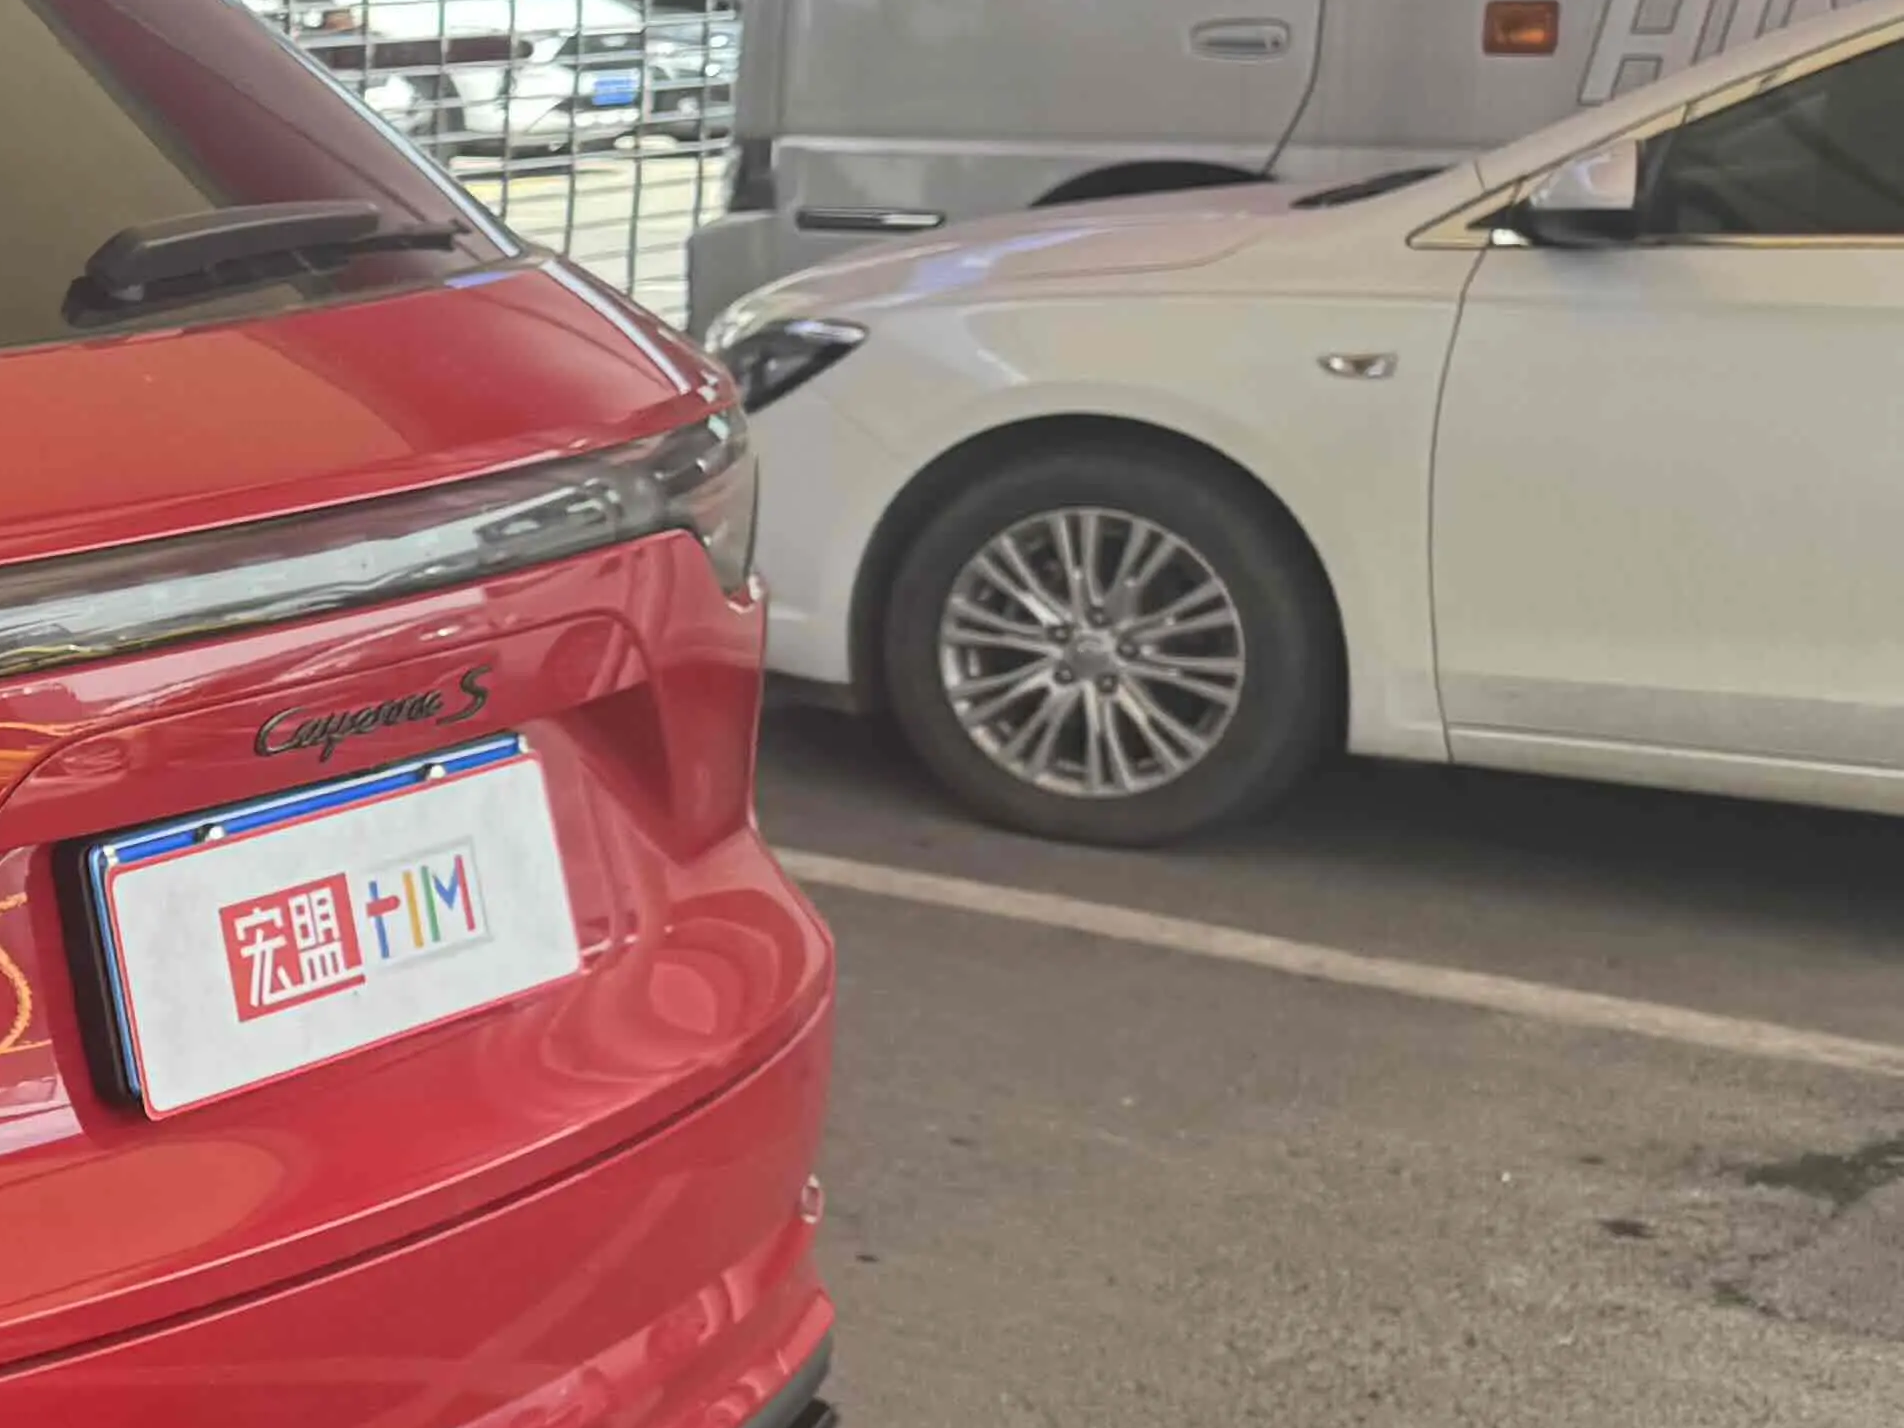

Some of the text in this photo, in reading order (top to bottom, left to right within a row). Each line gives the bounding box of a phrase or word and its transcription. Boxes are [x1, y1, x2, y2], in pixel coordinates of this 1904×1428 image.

[254, 665, 492, 763] Cayenne S
[233, 886, 363, 1008] 宏盟
